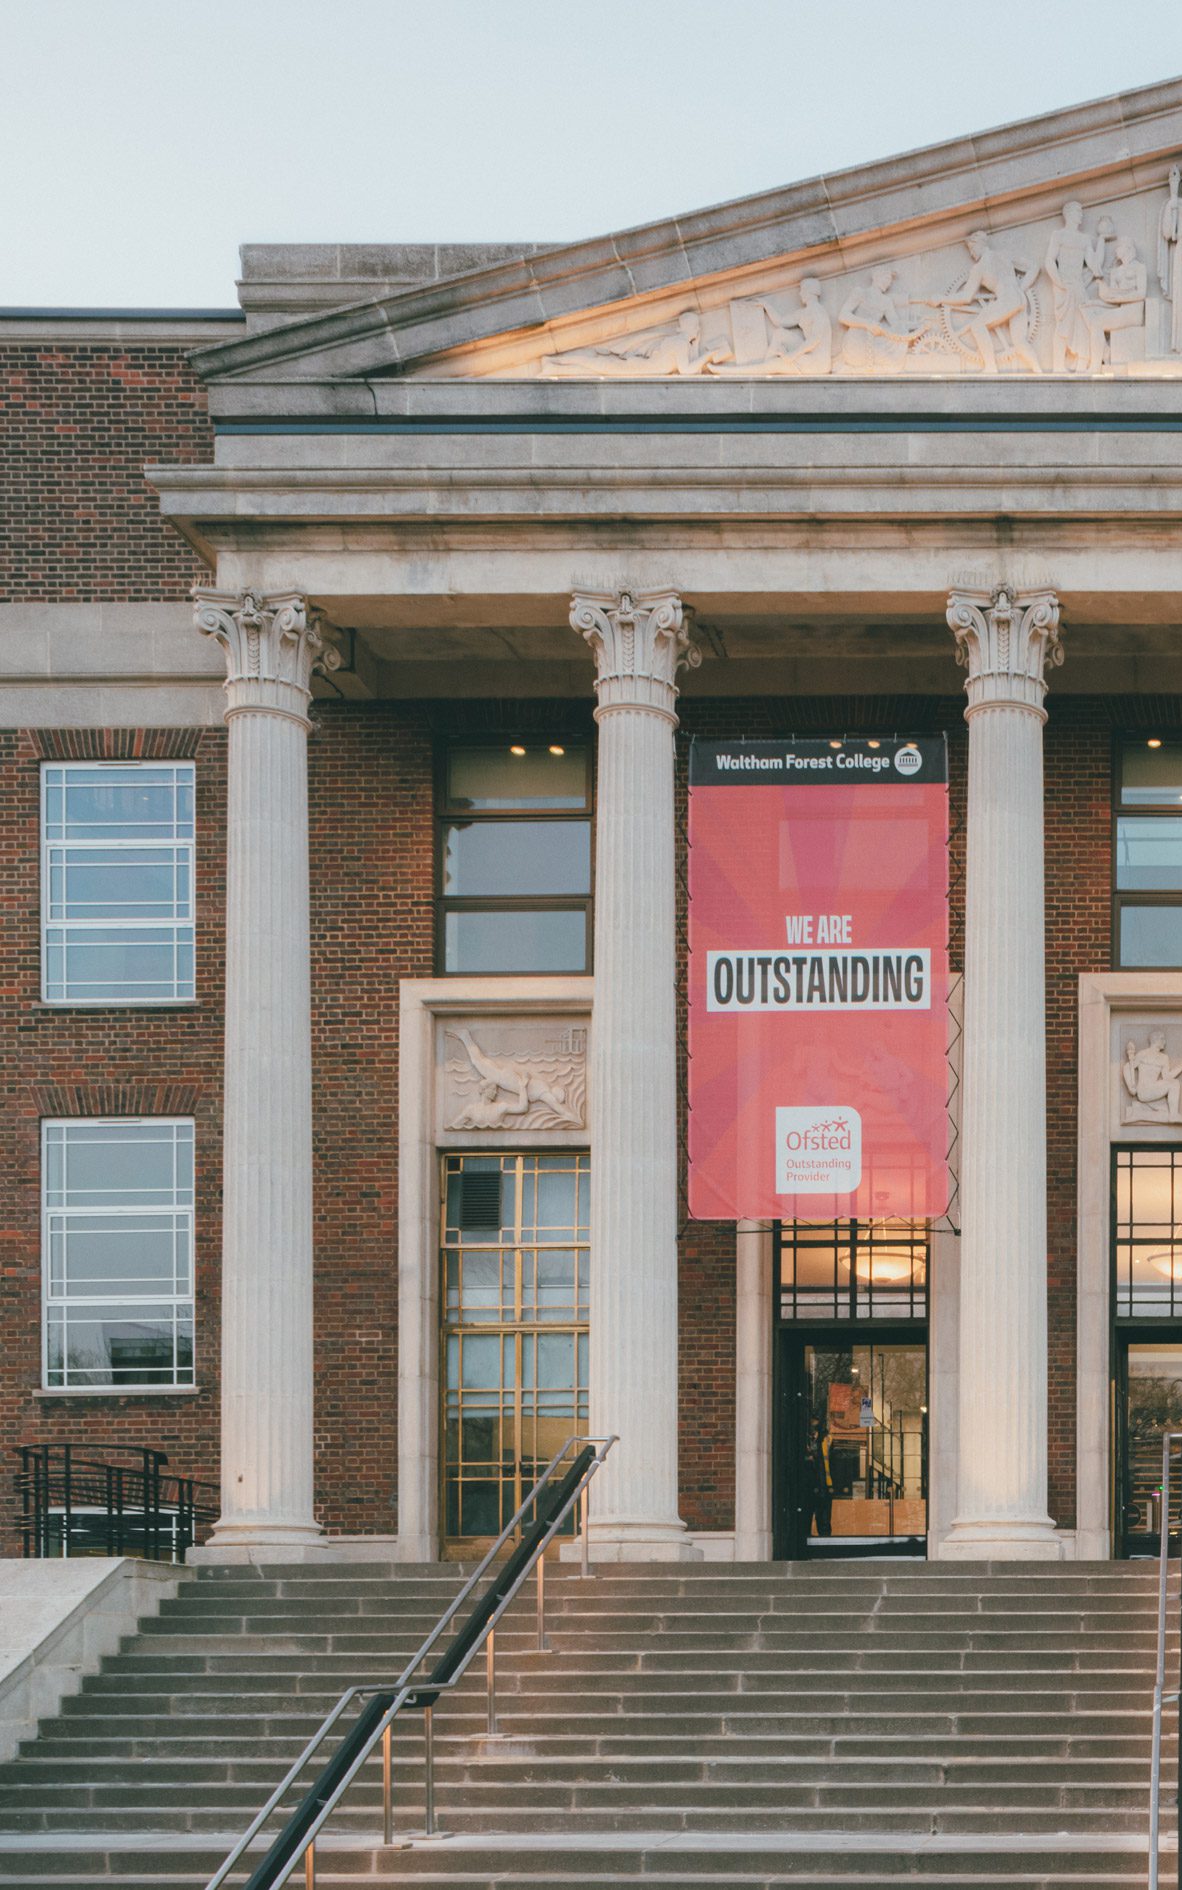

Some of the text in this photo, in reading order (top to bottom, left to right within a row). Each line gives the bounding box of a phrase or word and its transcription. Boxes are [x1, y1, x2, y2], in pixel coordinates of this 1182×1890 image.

[716, 753, 890, 772] Waltham Forest College
[785, 915, 853, 944] WE ARE
[713, 954, 924, 1006] OUTSTANDING
[786, 1129, 851, 1151] Ofsted
[786, 1158, 851, 1171] Outstanding
[786, 1171, 830, 1182] Provider
